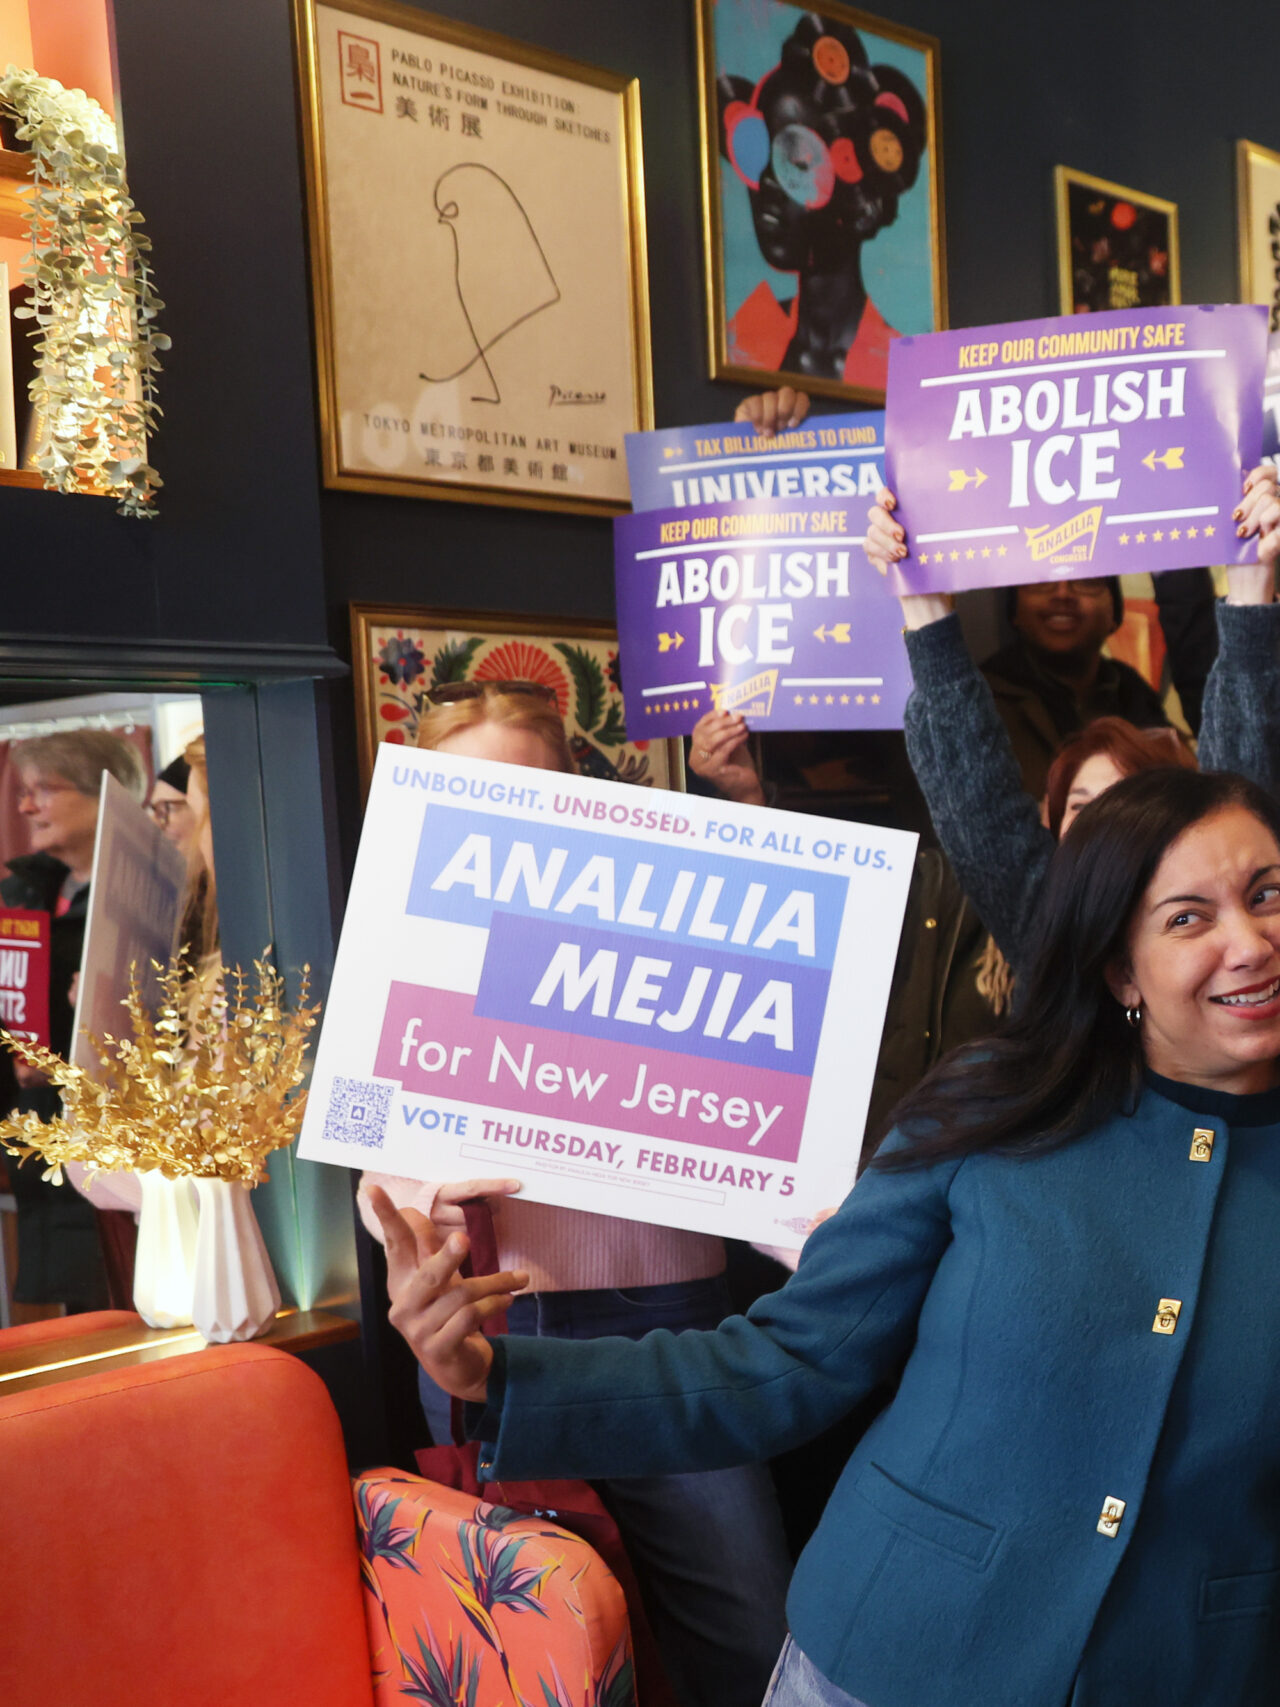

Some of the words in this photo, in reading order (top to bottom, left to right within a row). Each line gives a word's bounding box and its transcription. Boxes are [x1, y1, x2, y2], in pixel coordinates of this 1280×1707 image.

[392, 49, 432, 73] PABLO
[440, 61, 495, 91] PICASSO
[396, 96, 483, 139] 美術展
[457, 90, 488, 111] FORM
[496, 101, 548, 127] THROUGH
[555, 116, 611, 144] SKETCHES
[958, 342, 999, 369] KEEP
[1001, 338, 1034, 363] OUR
[1037, 326, 1141, 360] COMMUNITY
[1142, 323, 1186, 348] SAFE
[948, 367, 1187, 441] ABOLISH
[364, 414, 411, 433] TOKYO
[420, 422, 527, 449] METROPOLITAN
[536, 437, 559, 453] ART
[569, 443, 617, 461] MUSEUM
[694, 439, 722, 458] TAX
[723, 431, 817, 456] BILLIONAIRES
[819, 429, 836, 446] TO
[839, 426, 876, 446] FUND
[1008, 428, 1122, 509] ICE
[660, 519, 691, 544] KEEP
[692, 516, 718, 540] OUR
[720, 512, 809, 537] COMMUNITY
[811, 510, 848, 533] SAFE
[1036, 512, 1095, 556] ANALILIA
[655, 551, 850, 608] ABOLISH
[698, 603, 795, 667] ICE
[723, 674, 771, 707] NALILIA
[392, 766, 544, 811] UNBOUGHT.
[552, 793, 697, 837] UNBOSSED.
[704, 820, 755, 847] FOR
[761, 831, 804, 856] ALL
[812, 839, 847, 862] OF
[853, 846, 894, 871] US.
[430, 833, 817, 958] ANALILIA
[529, 941, 795, 1052] MEJIA
[399, 1017, 472, 1077] for
[488, 1034, 609, 1103] New
[619, 1062, 784, 1148] Jersey
[401, 1104, 468, 1136] VOTE
[480, 1119, 625, 1169] THURSDAY,
[635, 1148, 775, 1197] FEBRUARY
[778, 1175, 796, 1198] 5
